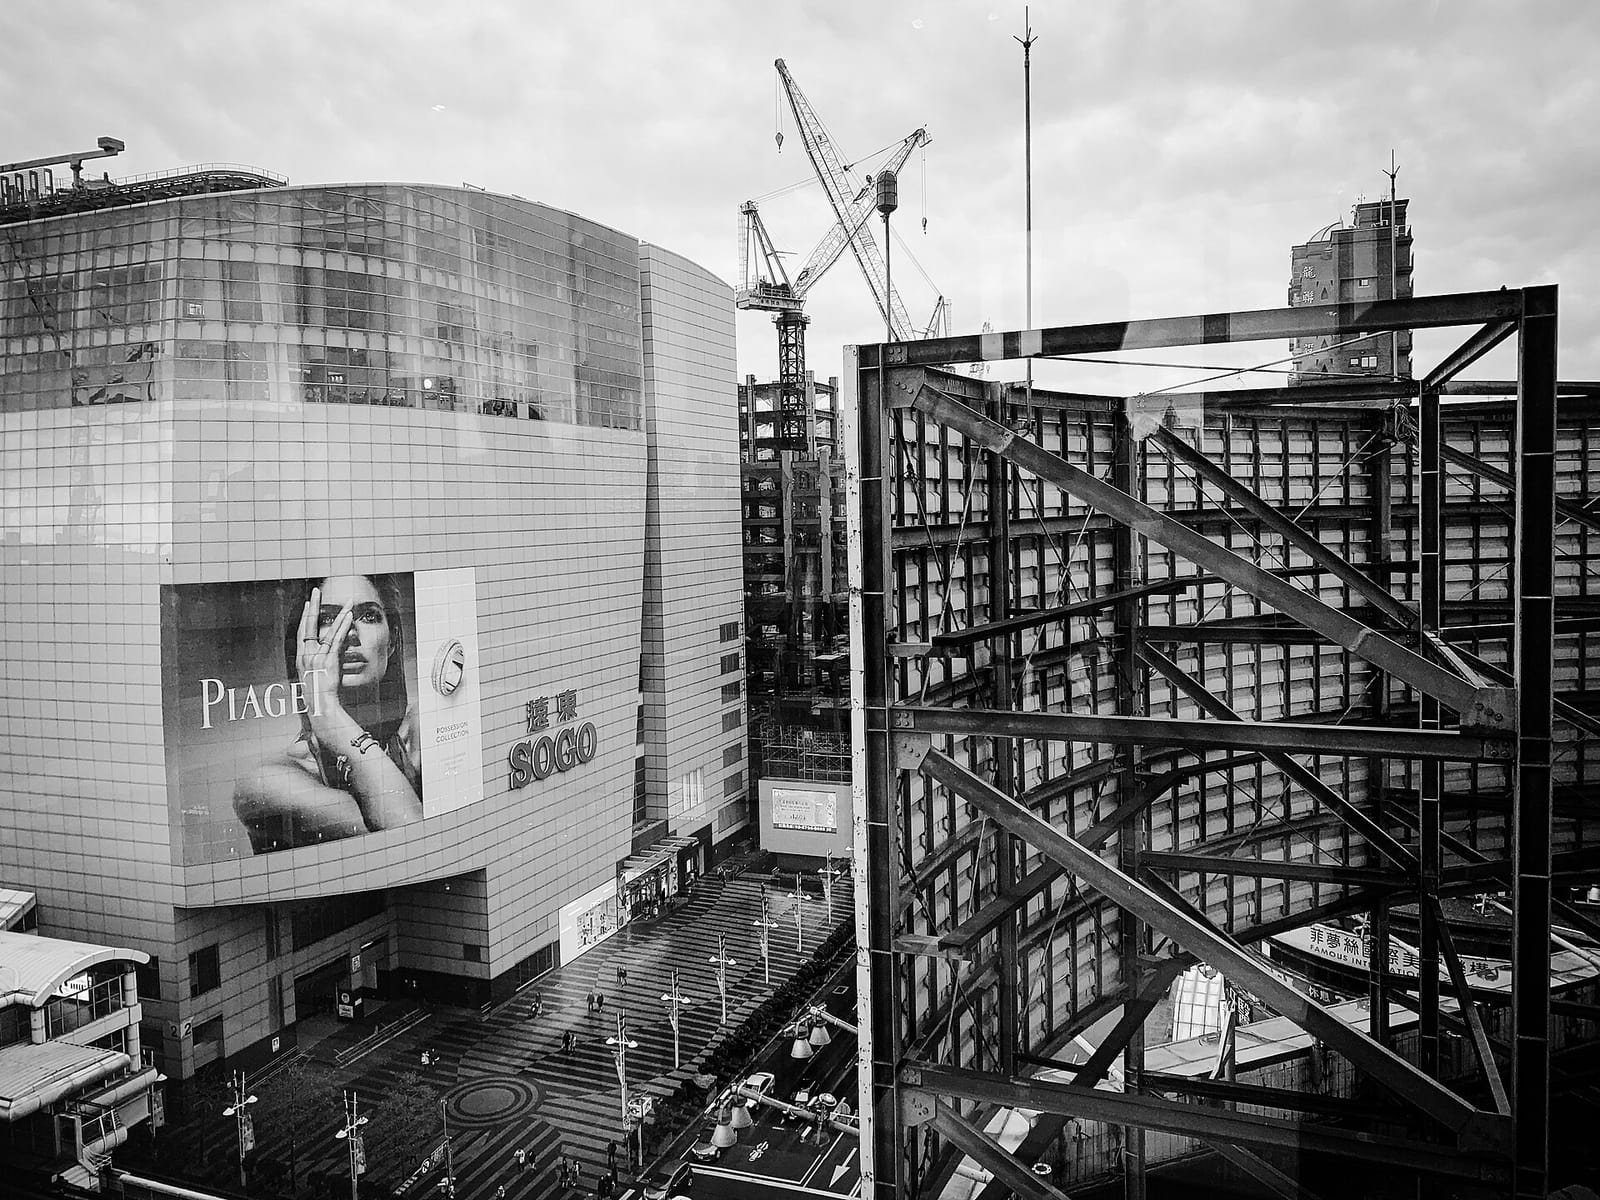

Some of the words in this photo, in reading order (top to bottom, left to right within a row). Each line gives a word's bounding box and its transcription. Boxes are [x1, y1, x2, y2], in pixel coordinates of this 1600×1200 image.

[199, 669, 328, 729] PIAGET
[527, 689, 577, 733] 遠東
[509, 722, 597, 789] SOGO
[1310, 944, 1348, 962] FAMOUS
[184, 1022, 192, 1036] 2
